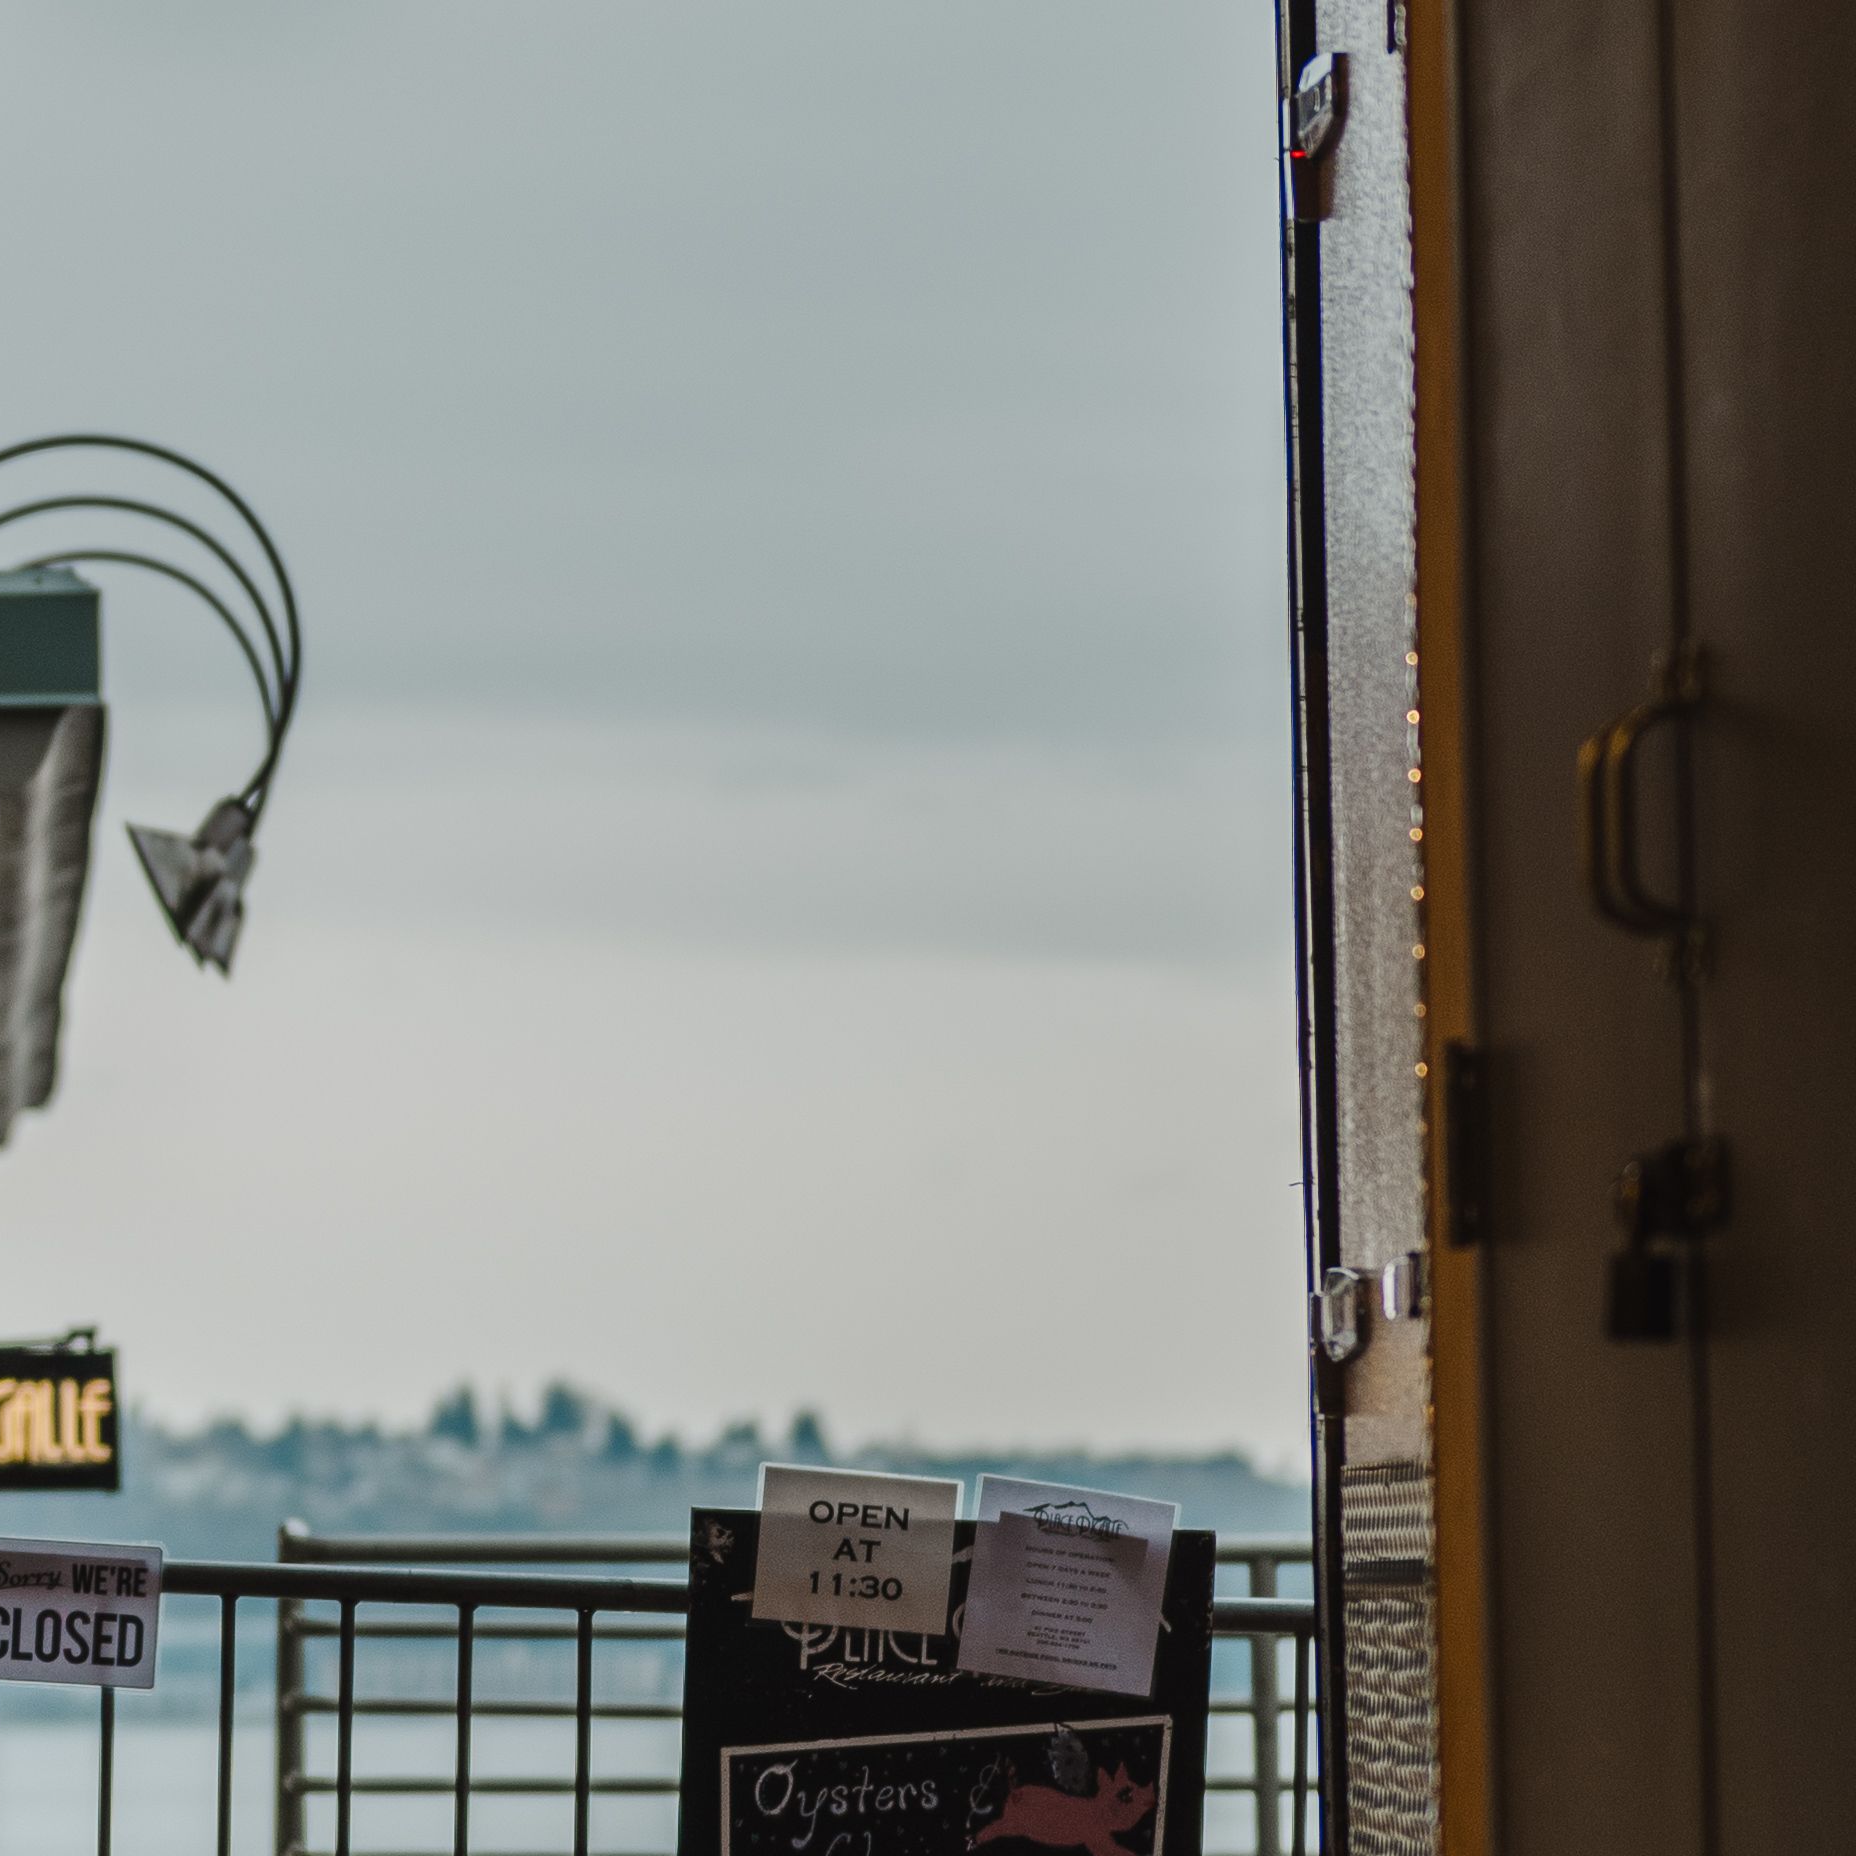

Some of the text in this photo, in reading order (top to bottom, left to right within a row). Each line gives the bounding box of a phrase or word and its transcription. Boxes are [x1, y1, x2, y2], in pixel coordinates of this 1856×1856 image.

[809, 1500, 909, 1531] OPEN
[832, 1538, 880, 1564] AT
[71, 1563, 148, 1598] WE'RE
[809, 1573, 903, 1601] 11:30
[812, 1662, 961, 1690] Restaurant
[755, 1757, 938, 1848] Oysters
